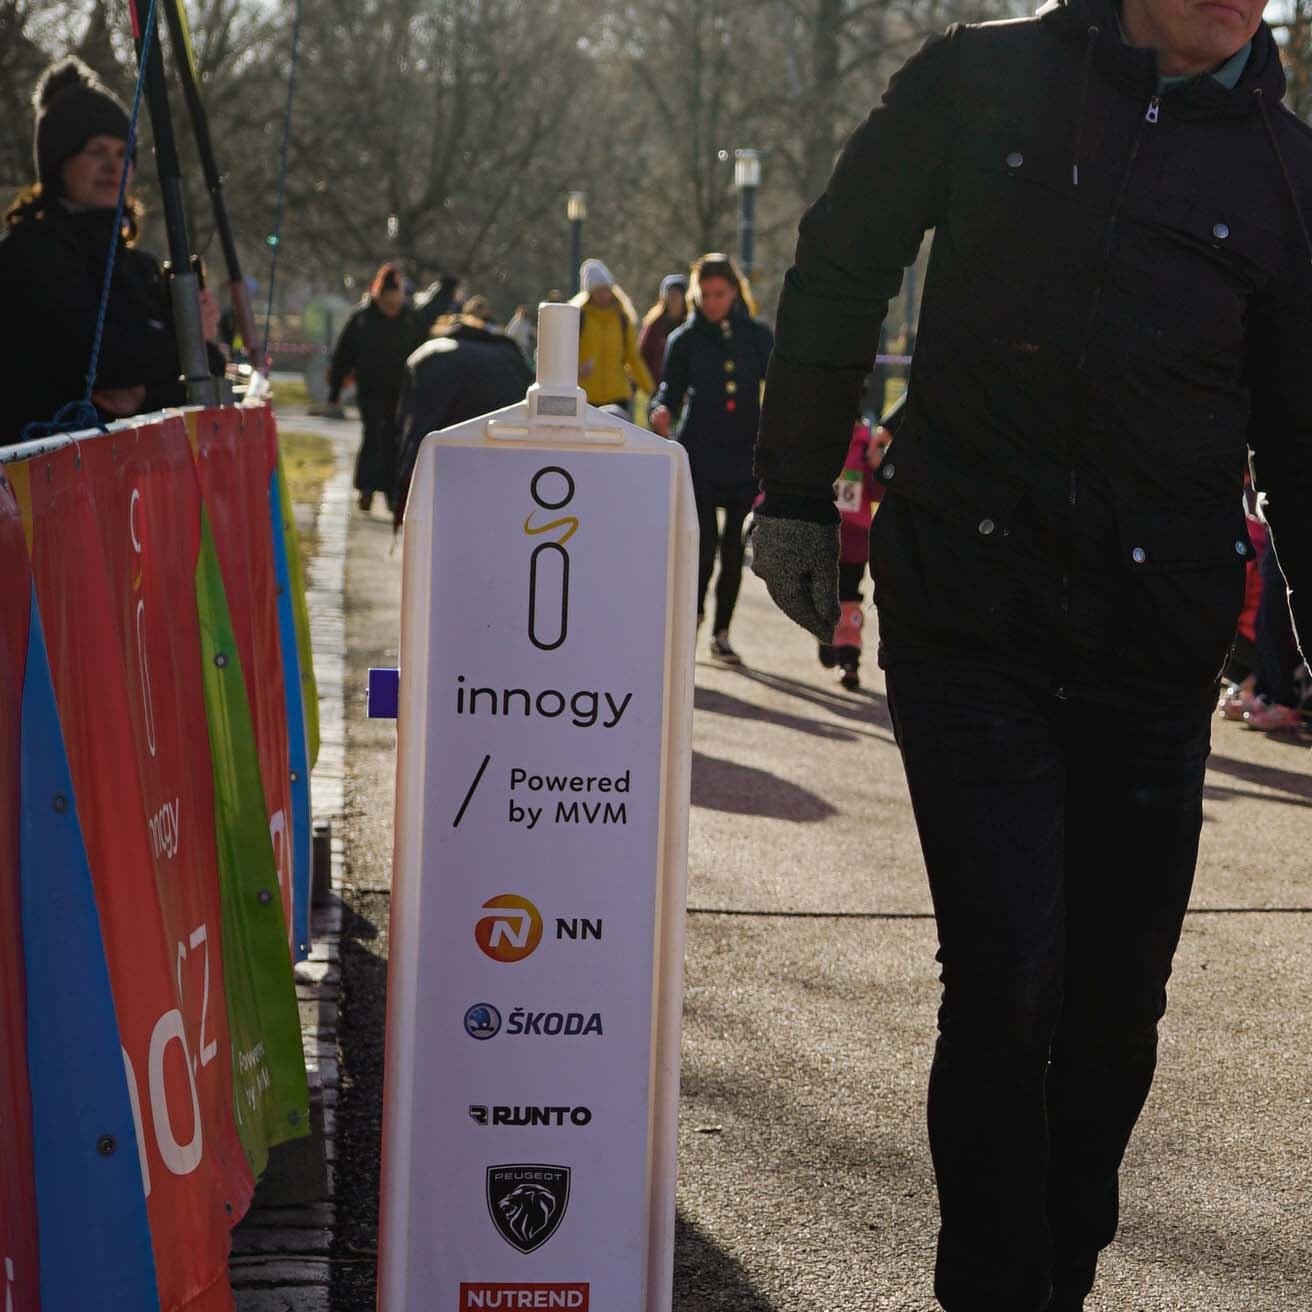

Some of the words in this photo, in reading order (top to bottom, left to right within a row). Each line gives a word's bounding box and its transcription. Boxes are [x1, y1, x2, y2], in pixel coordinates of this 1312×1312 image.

[457, 675, 632, 728] innogy
[510, 768, 630, 793] Powered
[508, 799, 542, 829] by
[555, 801, 627, 825] MVM
[555, 918, 602, 939] NN
[506, 1007, 603, 1036] ŠKODA
[492, 1105, 592, 1126] RUNTO
[494, 1172, 563, 1181] PEUGEOT
[467, 1290, 583, 1308] NUTREND
